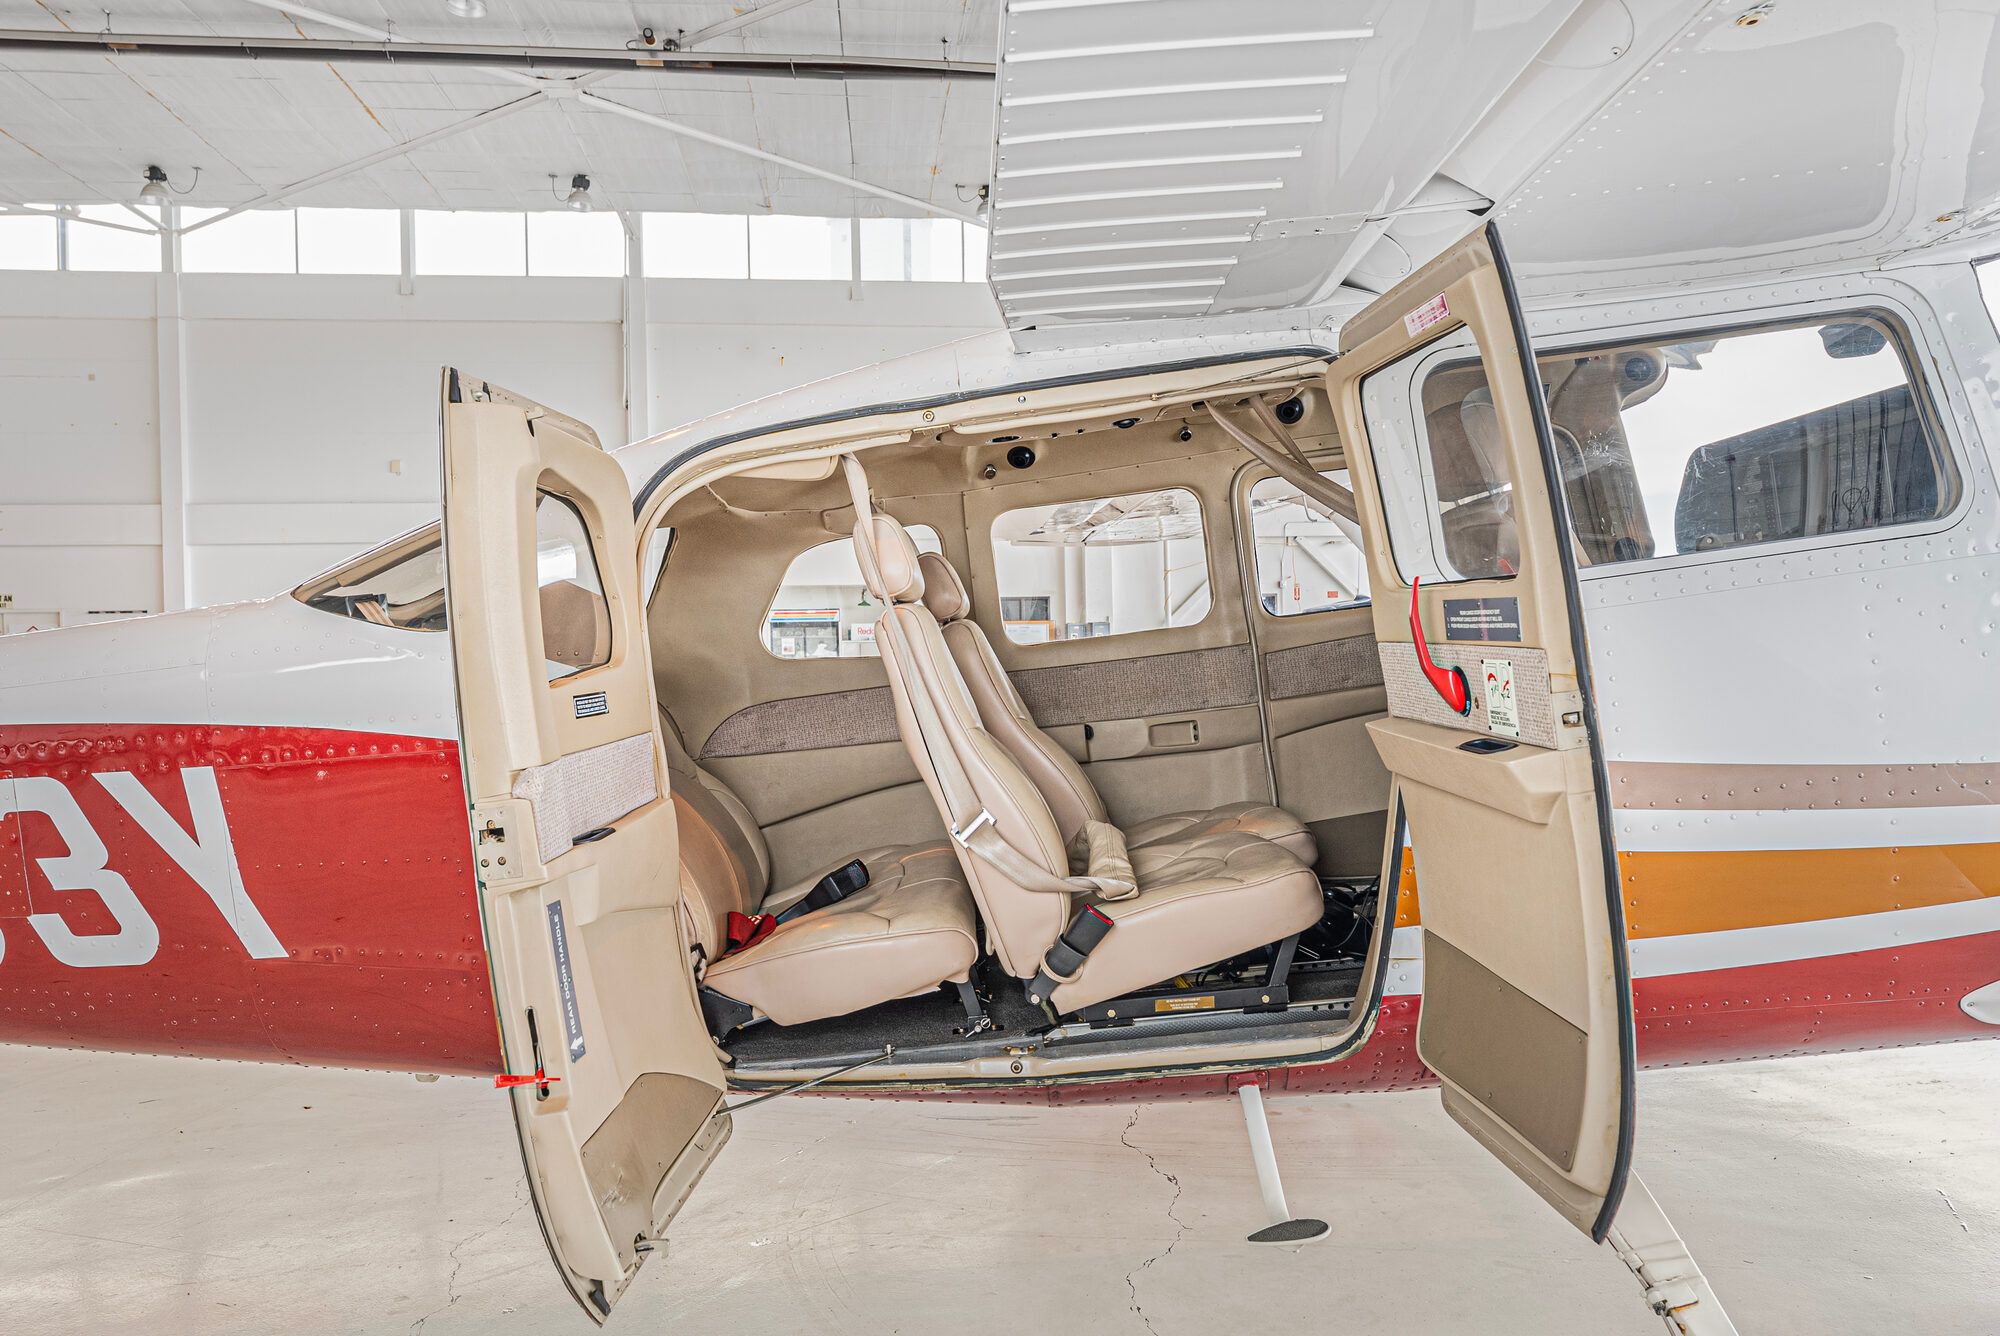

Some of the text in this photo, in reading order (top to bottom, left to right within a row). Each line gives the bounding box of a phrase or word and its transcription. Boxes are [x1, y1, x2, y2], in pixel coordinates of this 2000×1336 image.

[0, 766, 290, 968] 3Y
[553, 914, 577, 1034] REAR DOOR HANDLE
